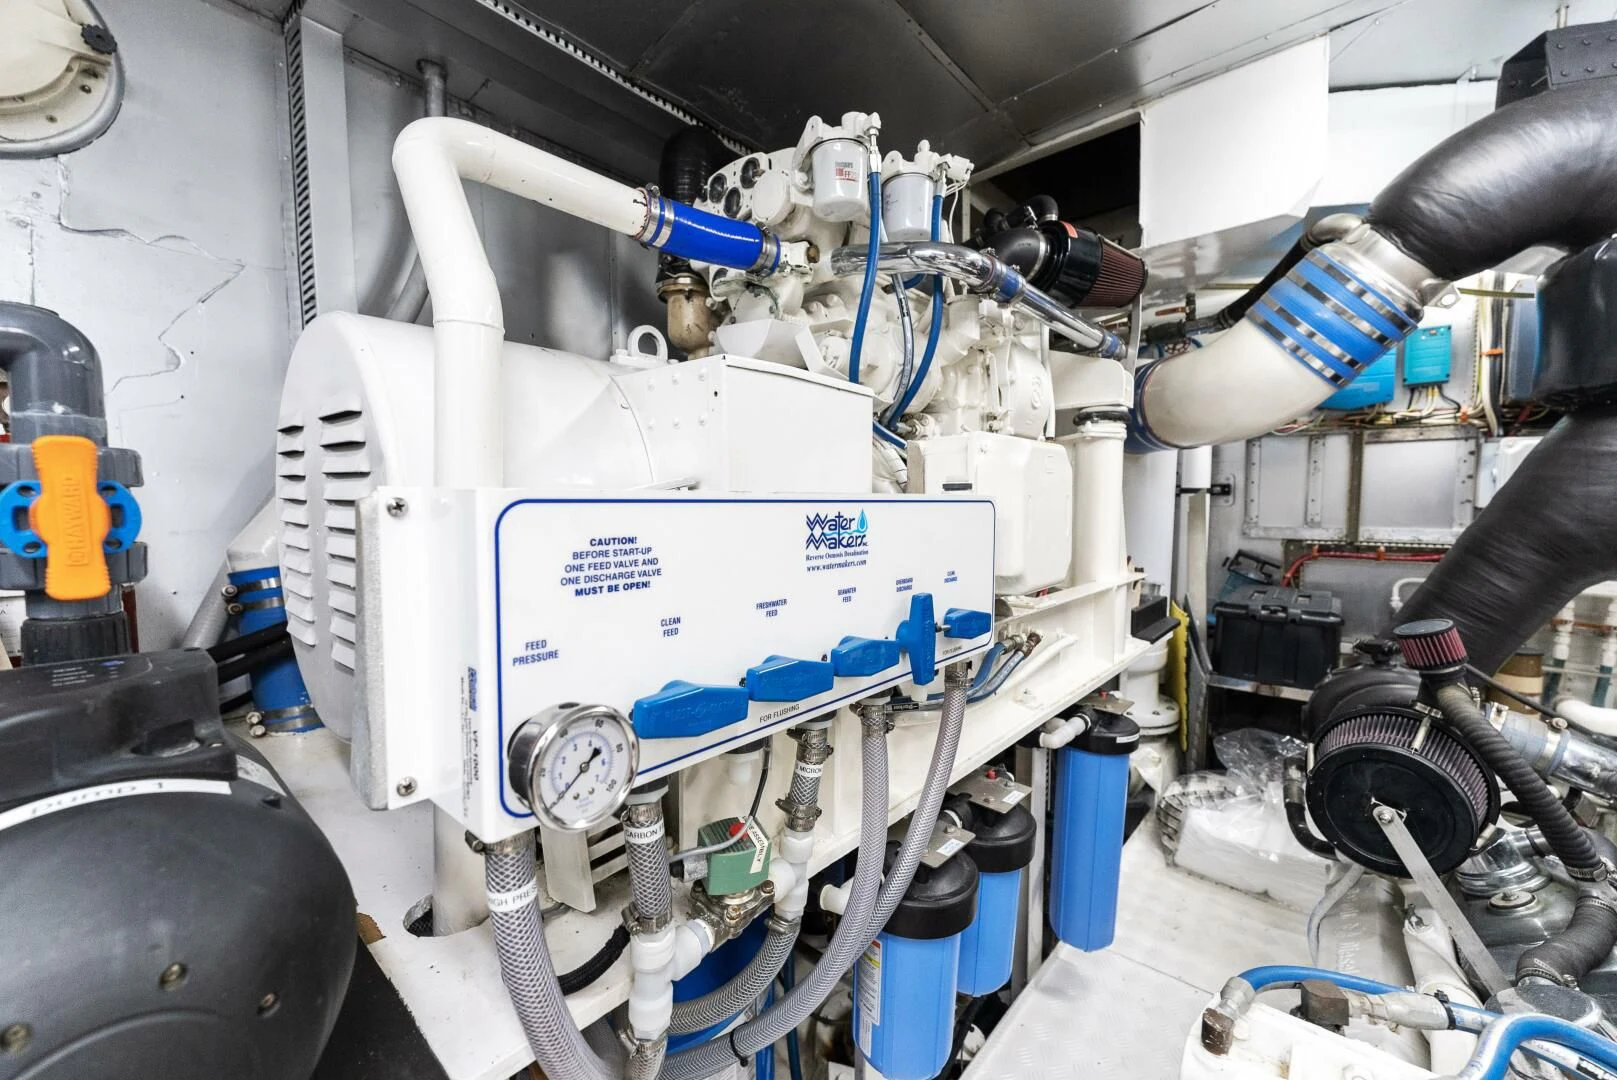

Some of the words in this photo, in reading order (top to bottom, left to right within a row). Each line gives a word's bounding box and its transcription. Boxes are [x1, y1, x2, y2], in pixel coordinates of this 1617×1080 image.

[62, 477, 86, 549] HAYWARD
[806, 511, 856, 531] Water
[590, 536, 637, 547] CAUTION!
[572, 550, 610, 560] BEFORE
[612, 547, 652, 557] START-UP
[806, 553, 824, 561] Reverse
[564, 563, 585, 573] ONE
[588, 561, 611, 571] FEED
[613, 559, 639, 569] VALVE
[641, 557, 659, 566] AND
[807, 559, 867, 572] www.watermakers.com
[560, 576, 581, 586] ONE
[584, 570, 636, 584] DISCHARGE
[637, 568, 662, 578] VALVE
[575, 586, 604, 596] MUST
[607, 584, 620, 593] BE
[622, 580, 651, 591] OPEN!
[837, 587, 857, 596] SEAWATER
[756, 598, 788, 610] FRESHWATER
[765, 609, 778, 617] FEED
[660, 616, 681, 627] CLEAN
[663, 627, 679, 637] FEED
[525, 639, 547, 651] FEED
[512, 650, 559, 667] PRESSURE
[760, 712, 773, 723] FOR
[773, 703, 800, 718] FLUSHING
[32, 786, 137, 816] pump
[625, 828, 658, 839] CARBON
[752, 831, 766, 862] ASSEMBLY
